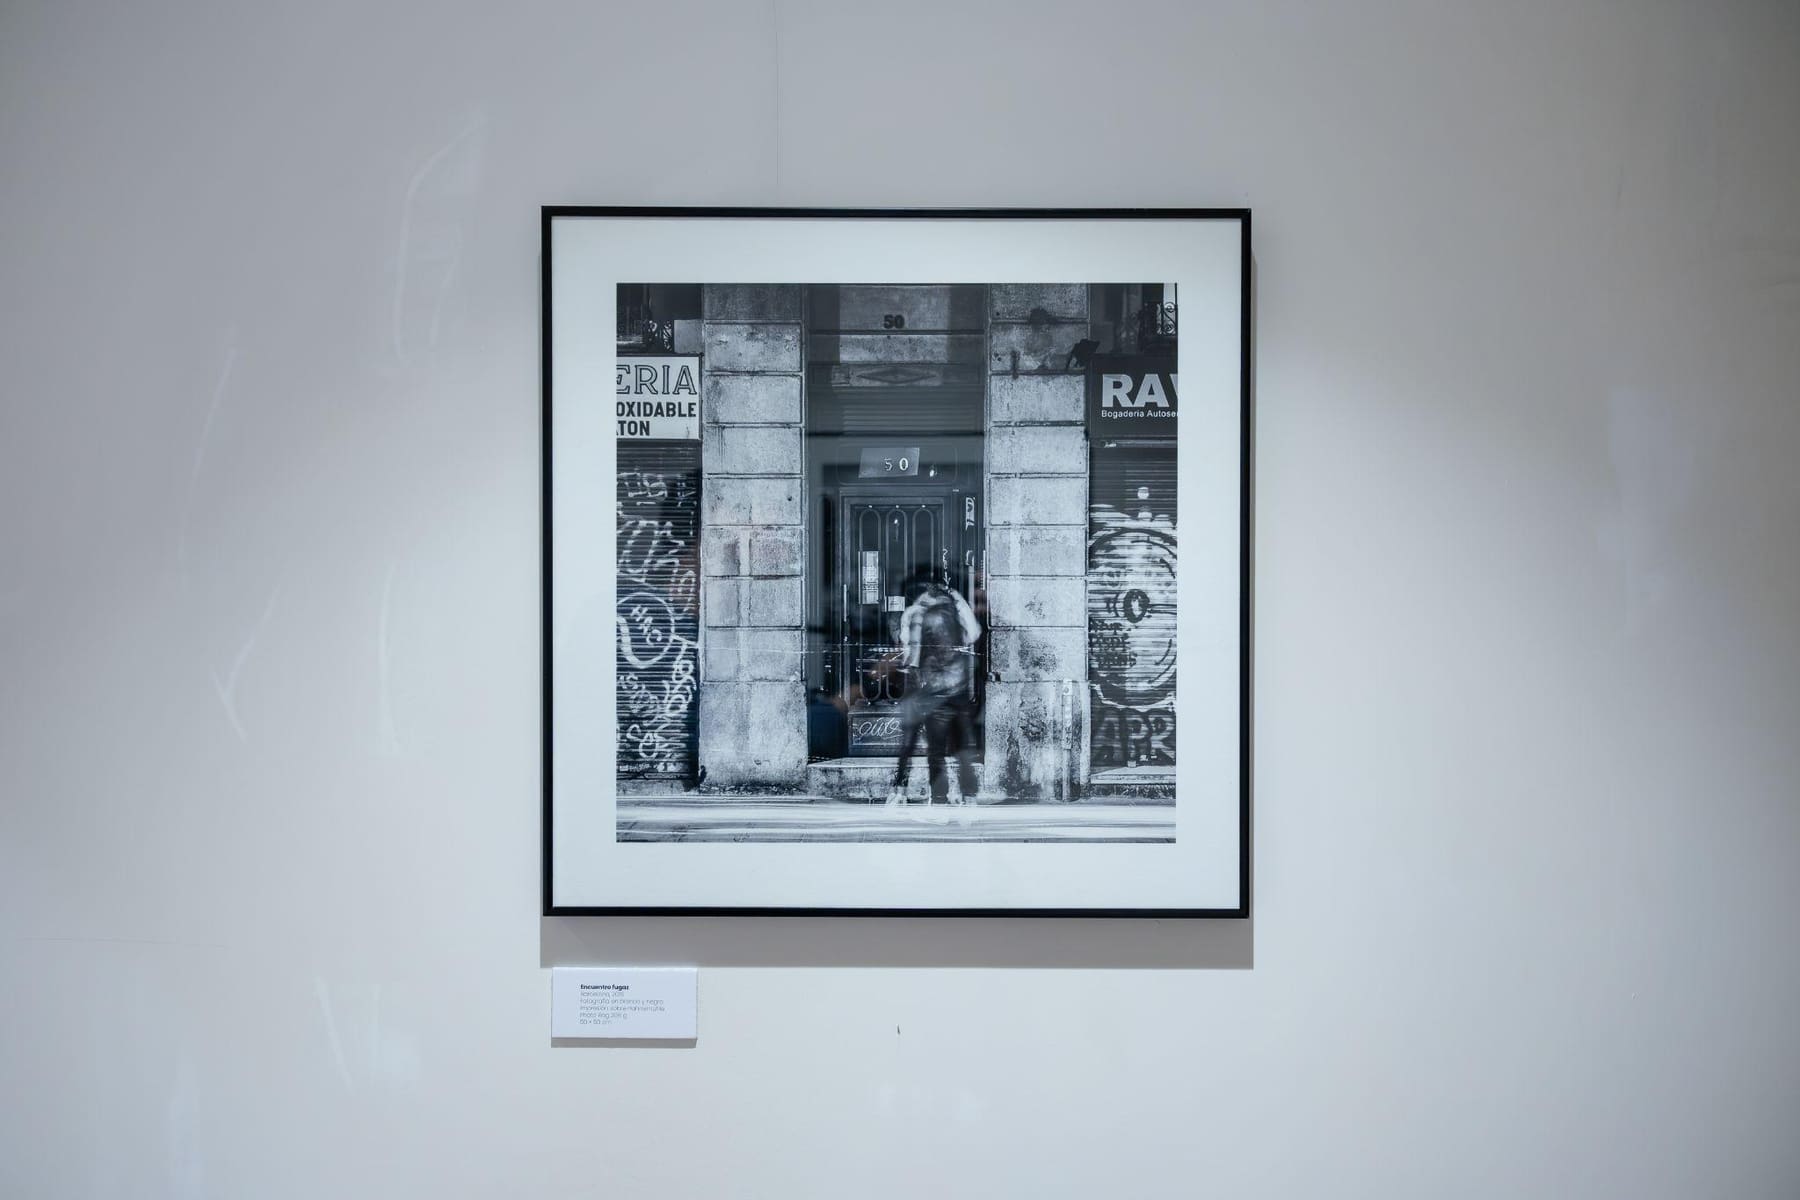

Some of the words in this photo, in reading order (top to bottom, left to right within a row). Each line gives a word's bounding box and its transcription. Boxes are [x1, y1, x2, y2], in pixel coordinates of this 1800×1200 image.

[883, 314, 905, 329] 50
[616, 401, 697, 417] OXIDABLE
[1146, 409, 1178, 418] Autose
[616, 420, 650, 436] TON
